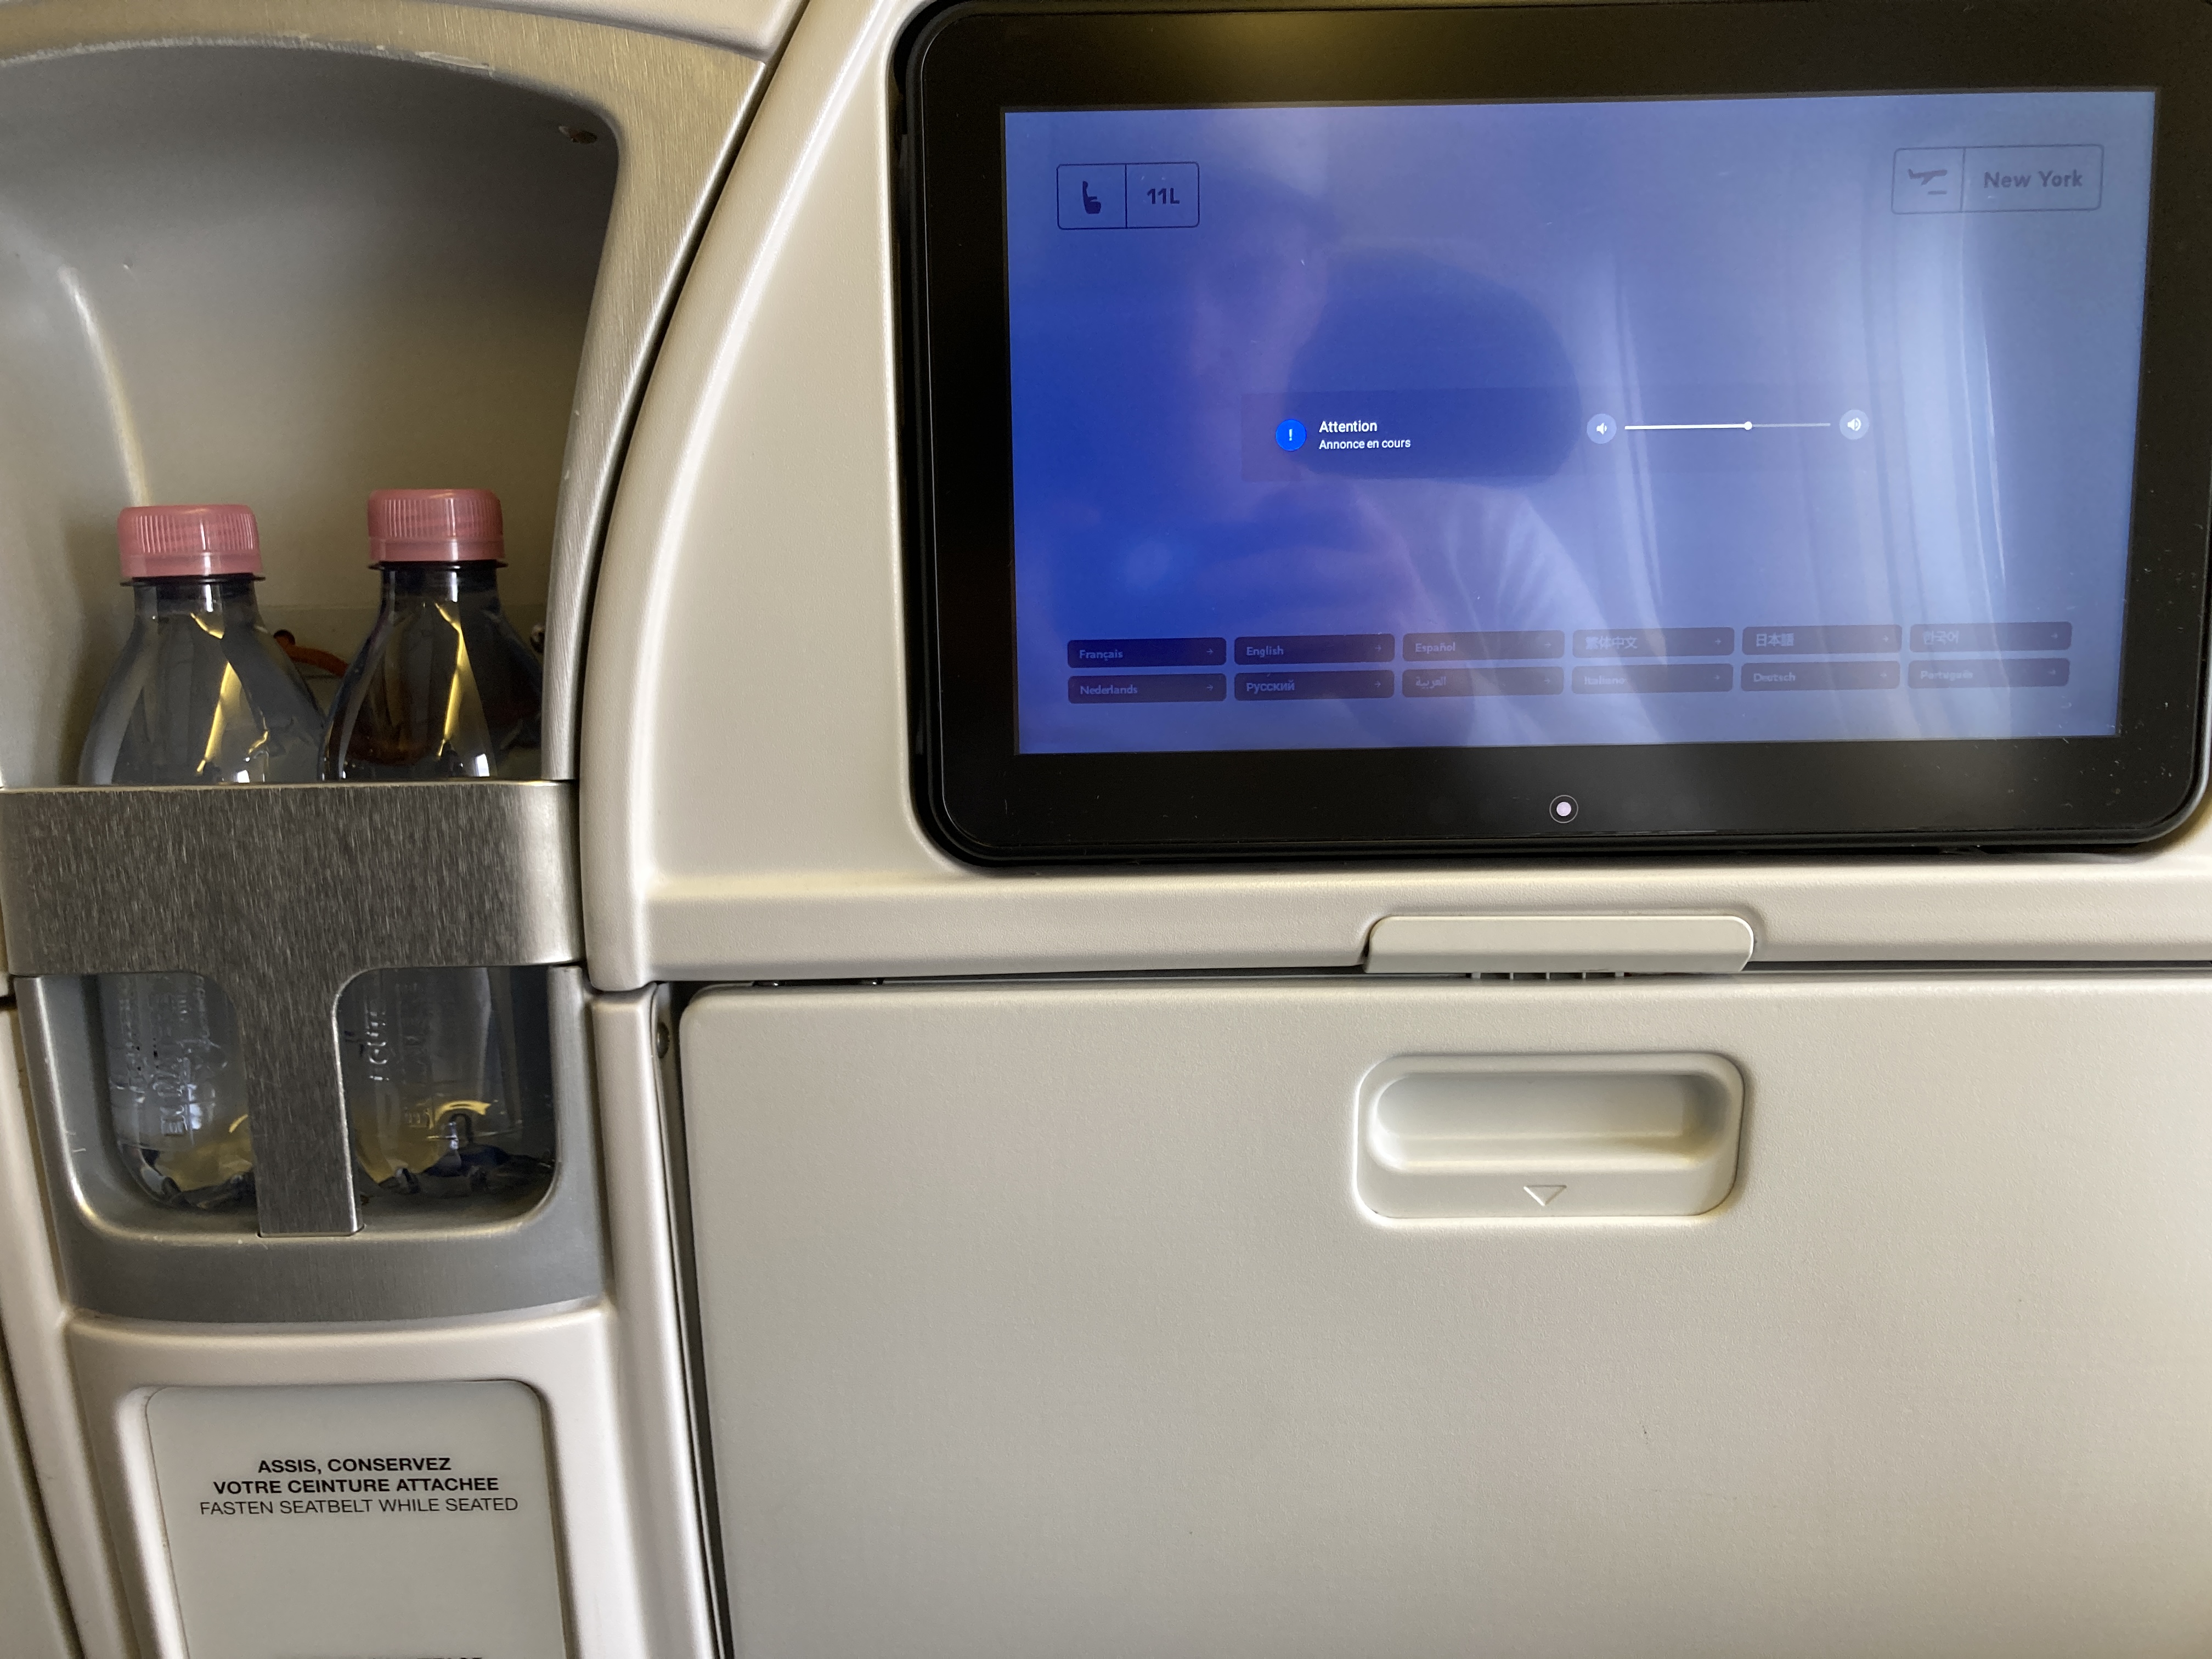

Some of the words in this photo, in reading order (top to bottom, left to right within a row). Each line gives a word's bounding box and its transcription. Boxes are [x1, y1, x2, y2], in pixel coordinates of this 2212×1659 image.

[1983, 171, 2032, 188] New
[2038, 169, 2083, 188] York
[1146, 187, 1180, 205] 11L
[1318, 420, 1378, 433] Attention
[1318, 439, 1365, 450] Annonce
[1367, 440, 1379, 449] en
[1381, 439, 1411, 448] cours
[1756, 632, 1795, 647] 日本語
[1246, 646, 1284, 658] English
[1415, 641, 1456, 654] Español
[1079, 649, 1124, 662] Français
[1753, 672, 1796, 682] Deutsch
[1080, 684, 1138, 696] Nederlands
[1246, 680, 1295, 693] Русский
[257, 1458, 322, 1475] ASSIS,
[328, 1457, 452, 1472] CONSERVEZ
[213, 1480, 283, 1495] VOTRE
[287, 1479, 391, 1493] CEINTURE
[396, 1477, 500, 1492] ATTACHEE
[200, 1500, 274, 1515] FASTEN
[280, 1499, 374, 1514] SEATBELT
[379, 1498, 440, 1513] WHILE
[445, 1497, 519, 1511] SEATED
